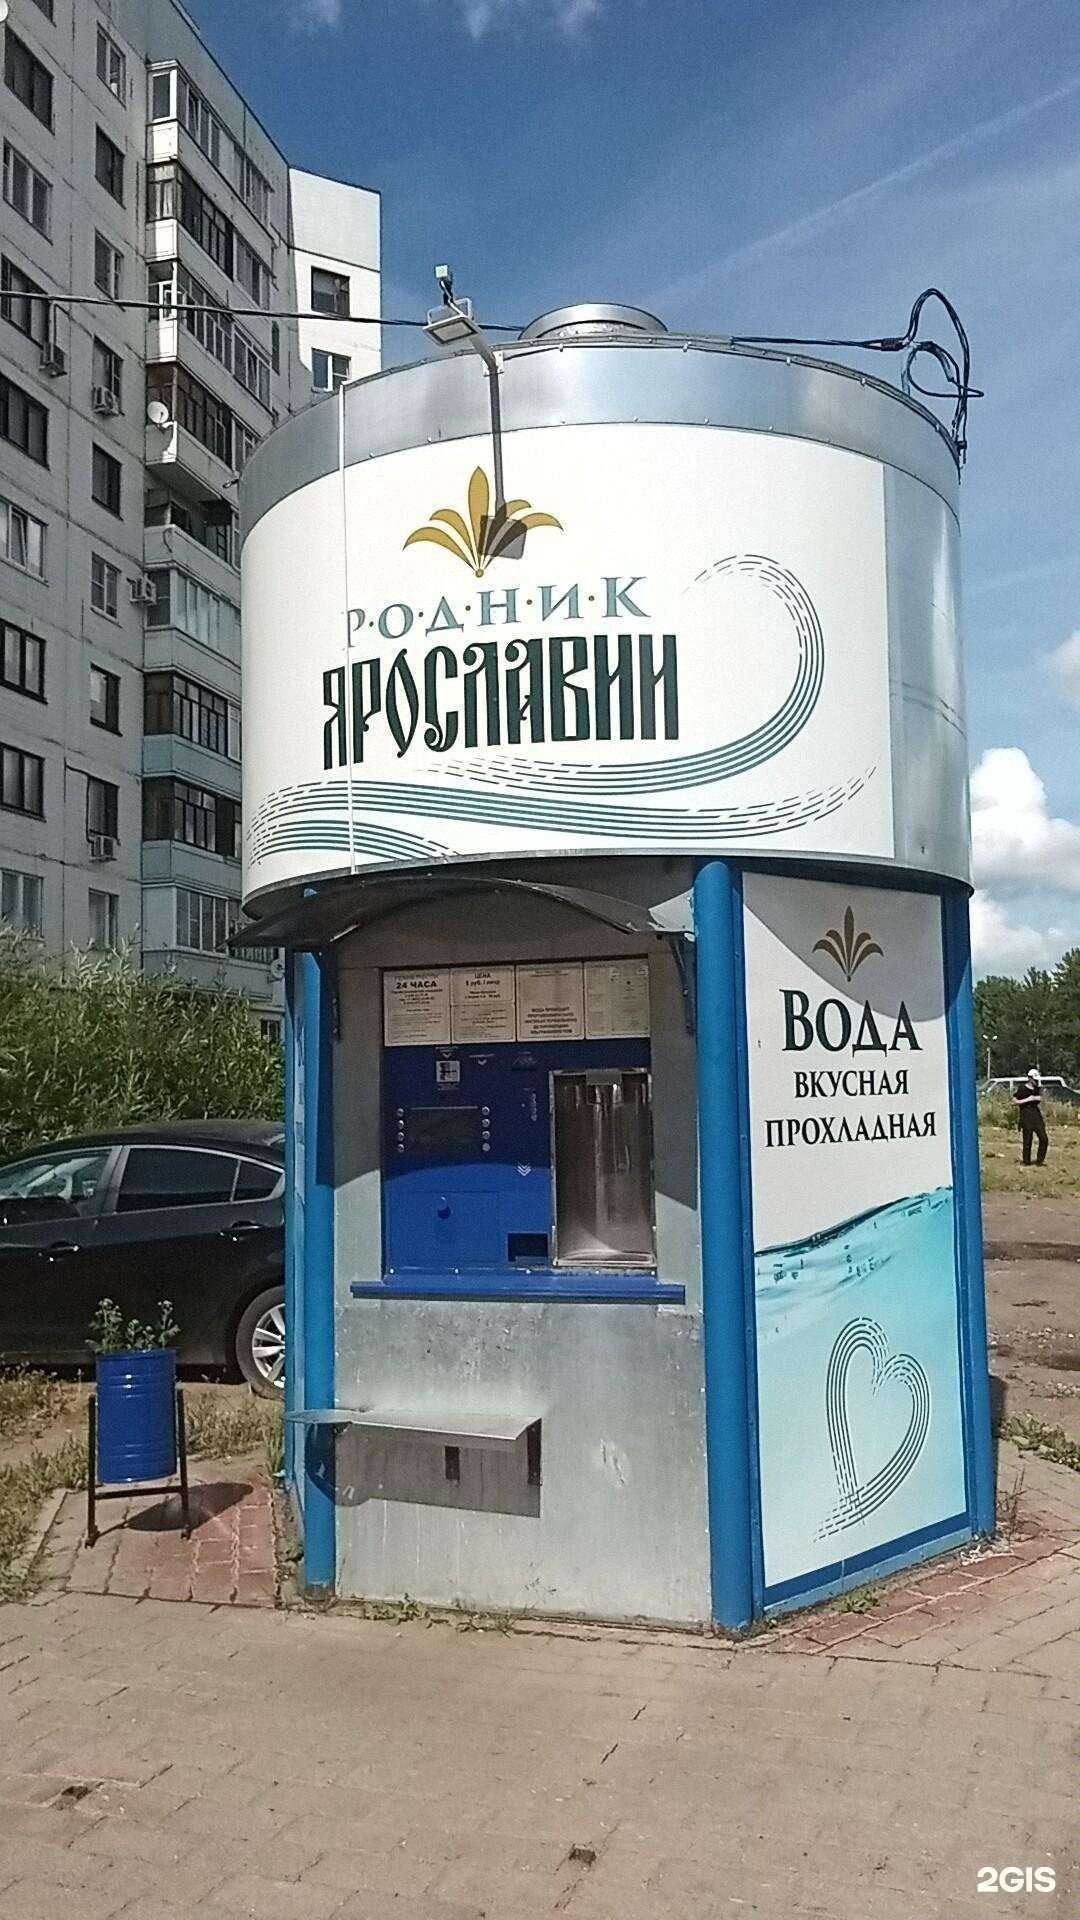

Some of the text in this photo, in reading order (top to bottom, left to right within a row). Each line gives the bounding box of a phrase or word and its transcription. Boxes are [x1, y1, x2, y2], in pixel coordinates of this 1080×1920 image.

[323, 634, 679, 770] ЯРОСЛАВИИ
[410, 980, 437, 989] ЧАСА
[779, 989, 923, 1058] ВОДА
[793, 1069, 910, 1099] ВКУСНАЯ
[765, 1111, 937, 1148] ПРОХЛАДНАЯ
